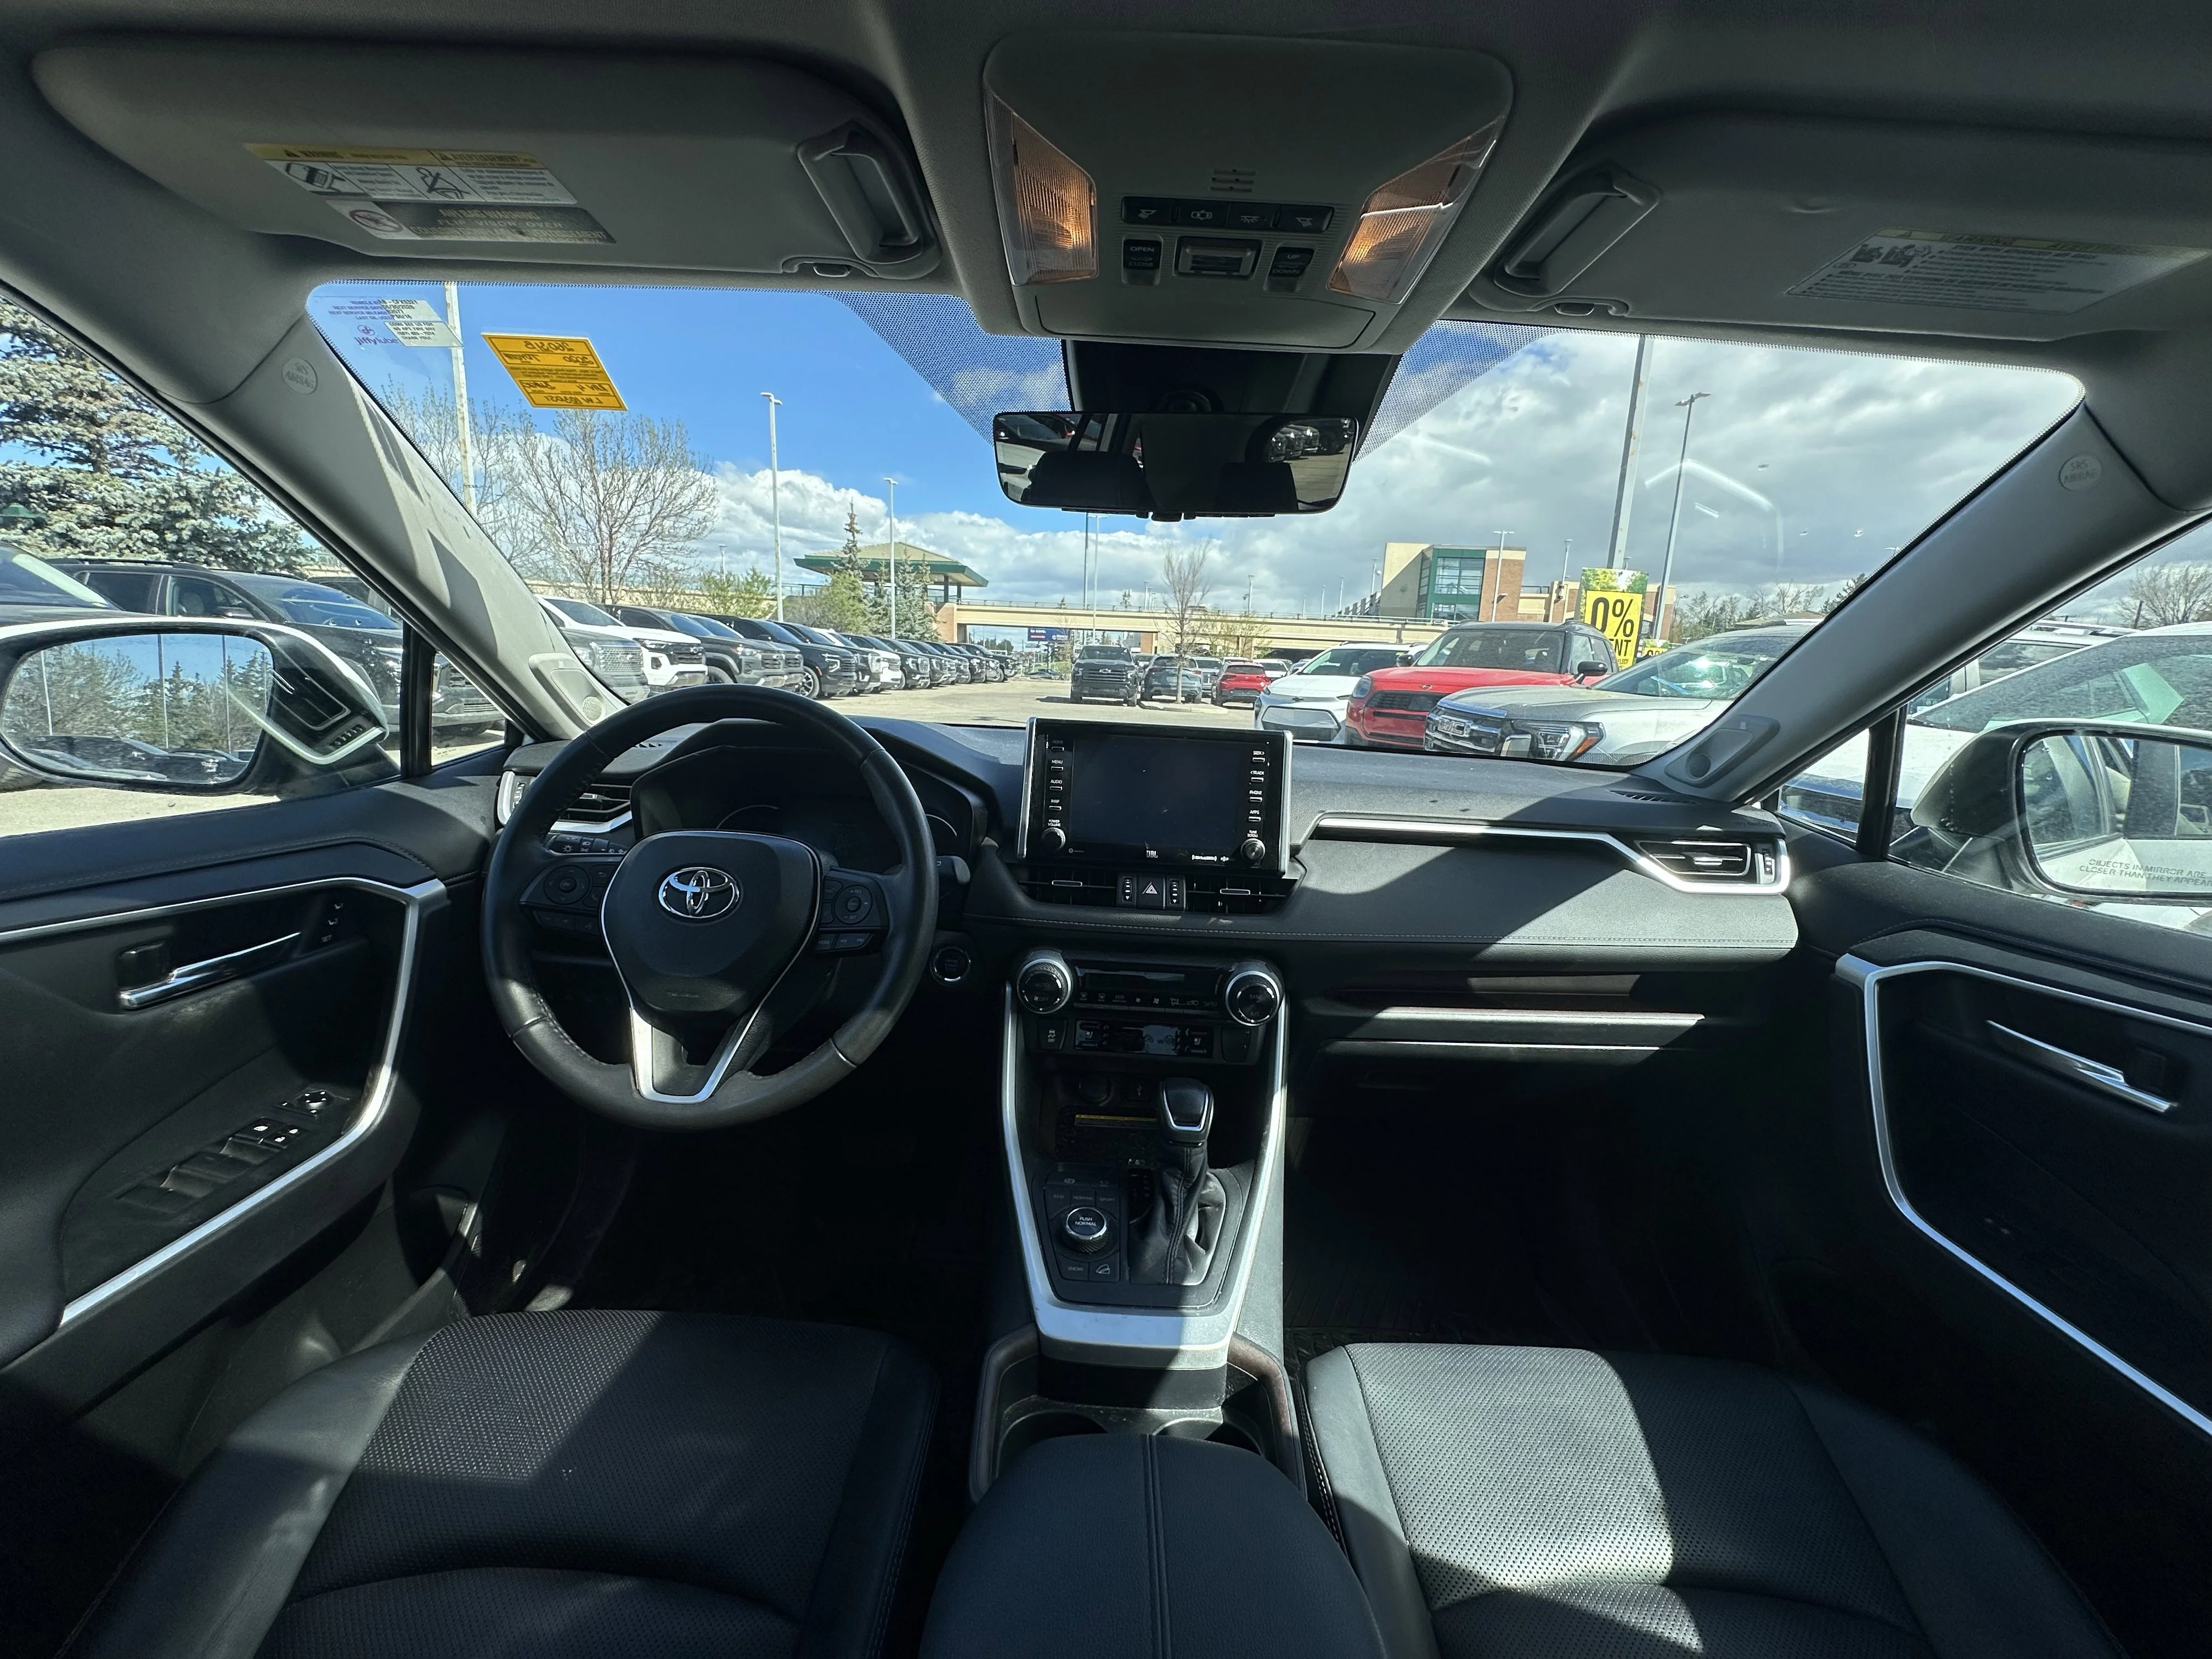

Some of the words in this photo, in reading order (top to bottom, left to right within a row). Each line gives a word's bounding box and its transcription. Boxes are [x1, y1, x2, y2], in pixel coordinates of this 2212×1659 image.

[294, 362, 309, 375] SRS
[285, 370, 314, 389] AIRBAG
[2070, 459, 2088, 471] SRS
[2064, 467, 2098, 484] AIRBAG
[1591, 596, 1634, 637] 0%
[1437, 718, 1465, 735] GMC
[1146, 850, 1158, 859] JBL
[2079, 865, 2116, 876] CLOSER
[2119, 869, 2145, 879] THAN
[2145, 873, 2172, 882] THEY
[2089, 859, 2130, 870] OBJECTS
[2143, 865, 2185, 876] MIRROR
[2186, 870, 2207, 878] ARE
[321, 934, 332, 943] SET
